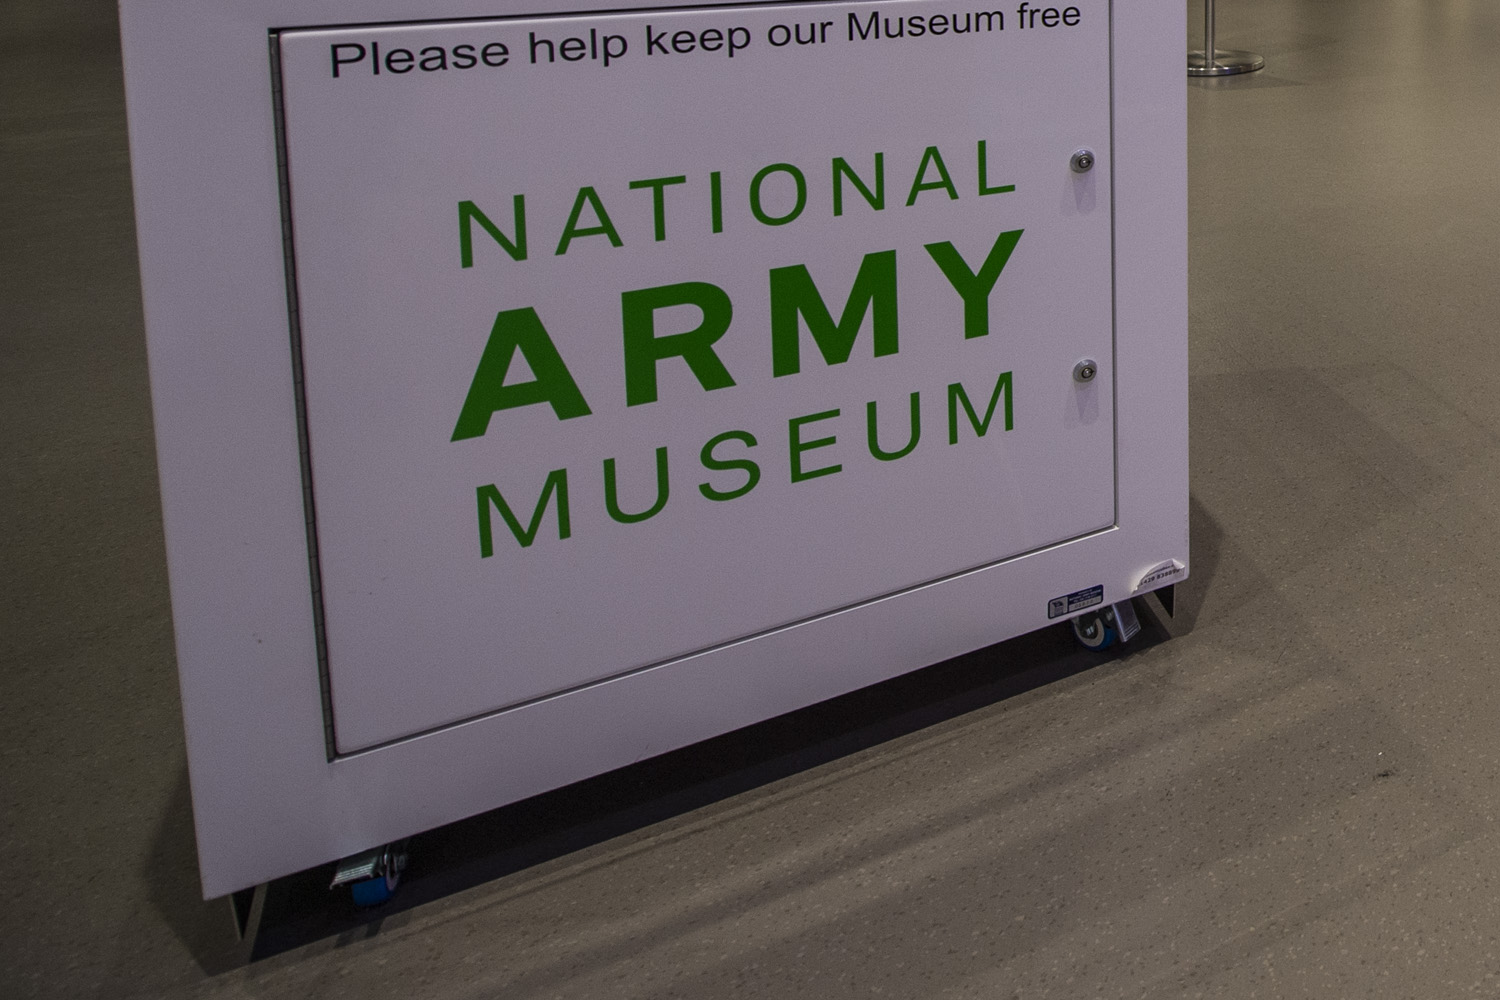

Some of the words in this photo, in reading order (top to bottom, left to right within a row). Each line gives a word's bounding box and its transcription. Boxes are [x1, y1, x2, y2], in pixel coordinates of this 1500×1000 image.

[331, 41, 509, 78] Please
[528, 28, 628, 67] help
[646, 25, 751, 58] keep
[767, 20, 833, 47] our
[847, 10, 1004, 41] Museum
[1016, 2, 1081, 30] free
[457, 139, 1016, 269] NATIONAL
[450, 228, 1025, 443] ARMY
[475, 371, 1015, 559] MUSEUM
